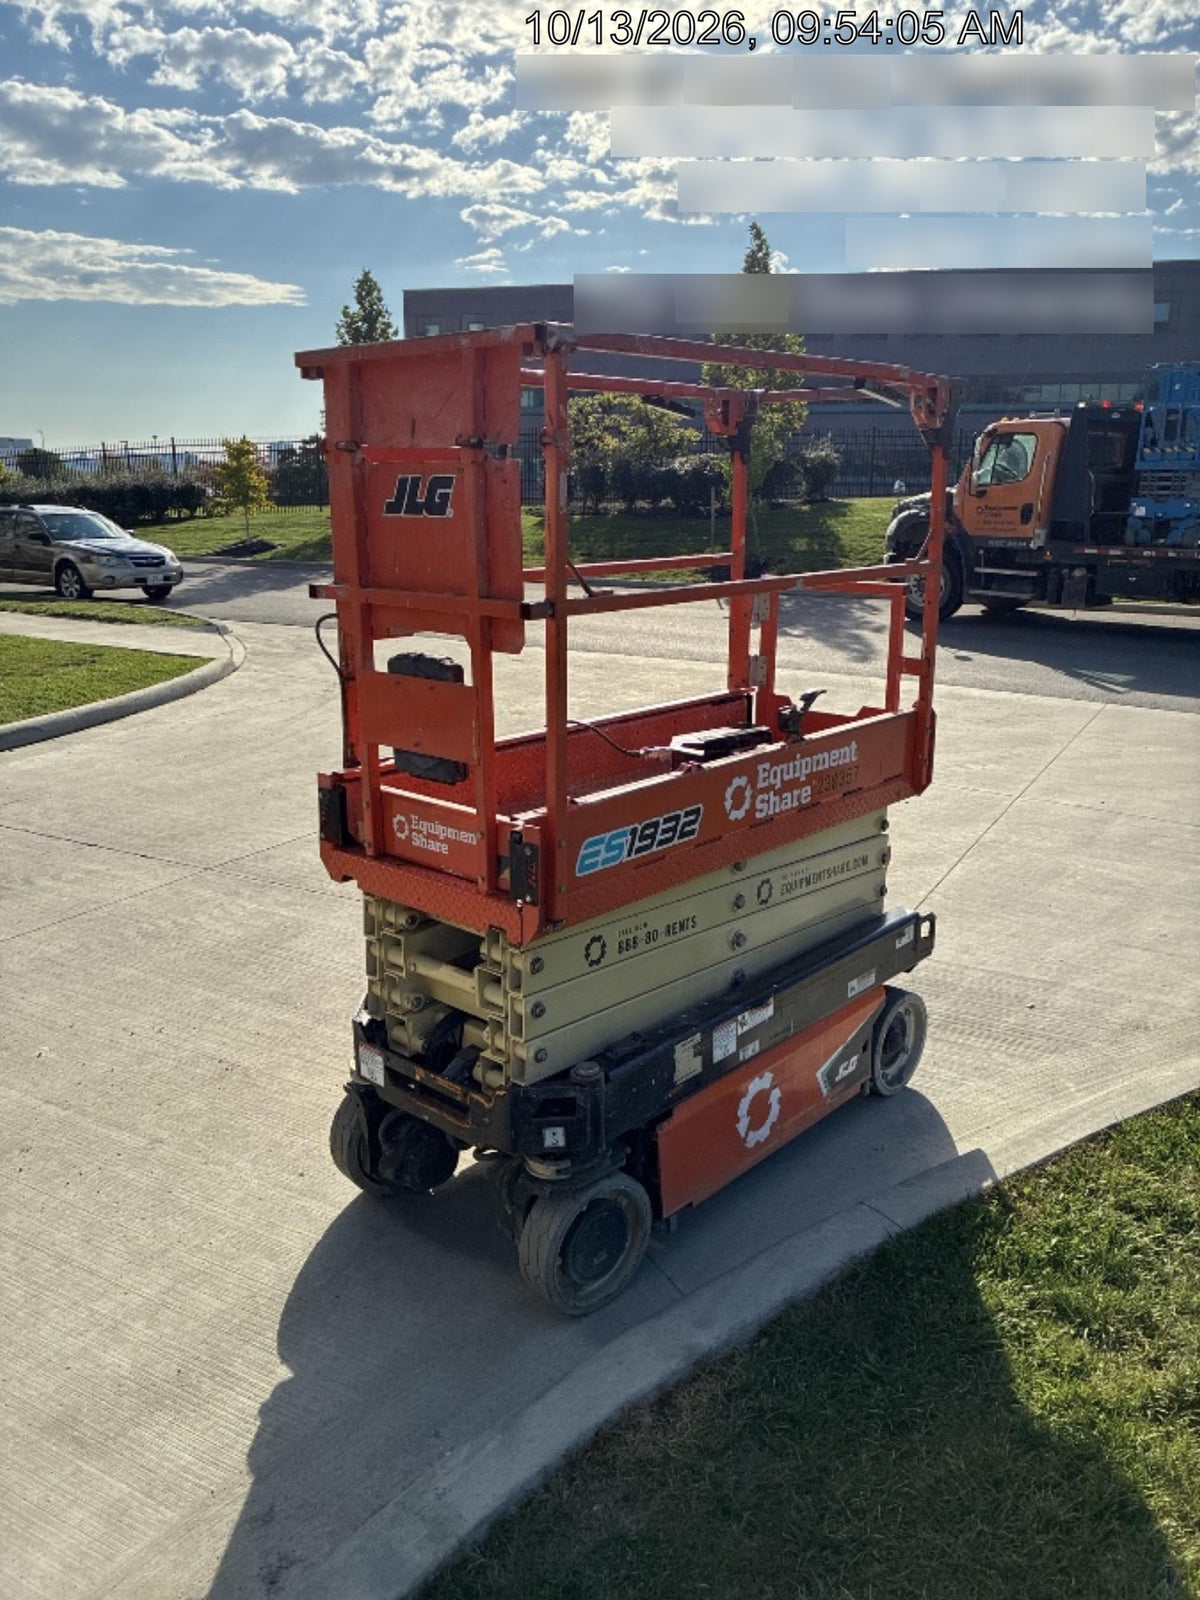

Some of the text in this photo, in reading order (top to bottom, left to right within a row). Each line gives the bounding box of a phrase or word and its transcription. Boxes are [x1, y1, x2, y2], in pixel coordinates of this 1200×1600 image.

[382, 474, 456, 518] JLG
[757, 740, 858, 790] Equipment
[755, 785, 811, 819] Share
[411, 831, 449, 854] Share
[576, 803, 704, 877] ES1932
